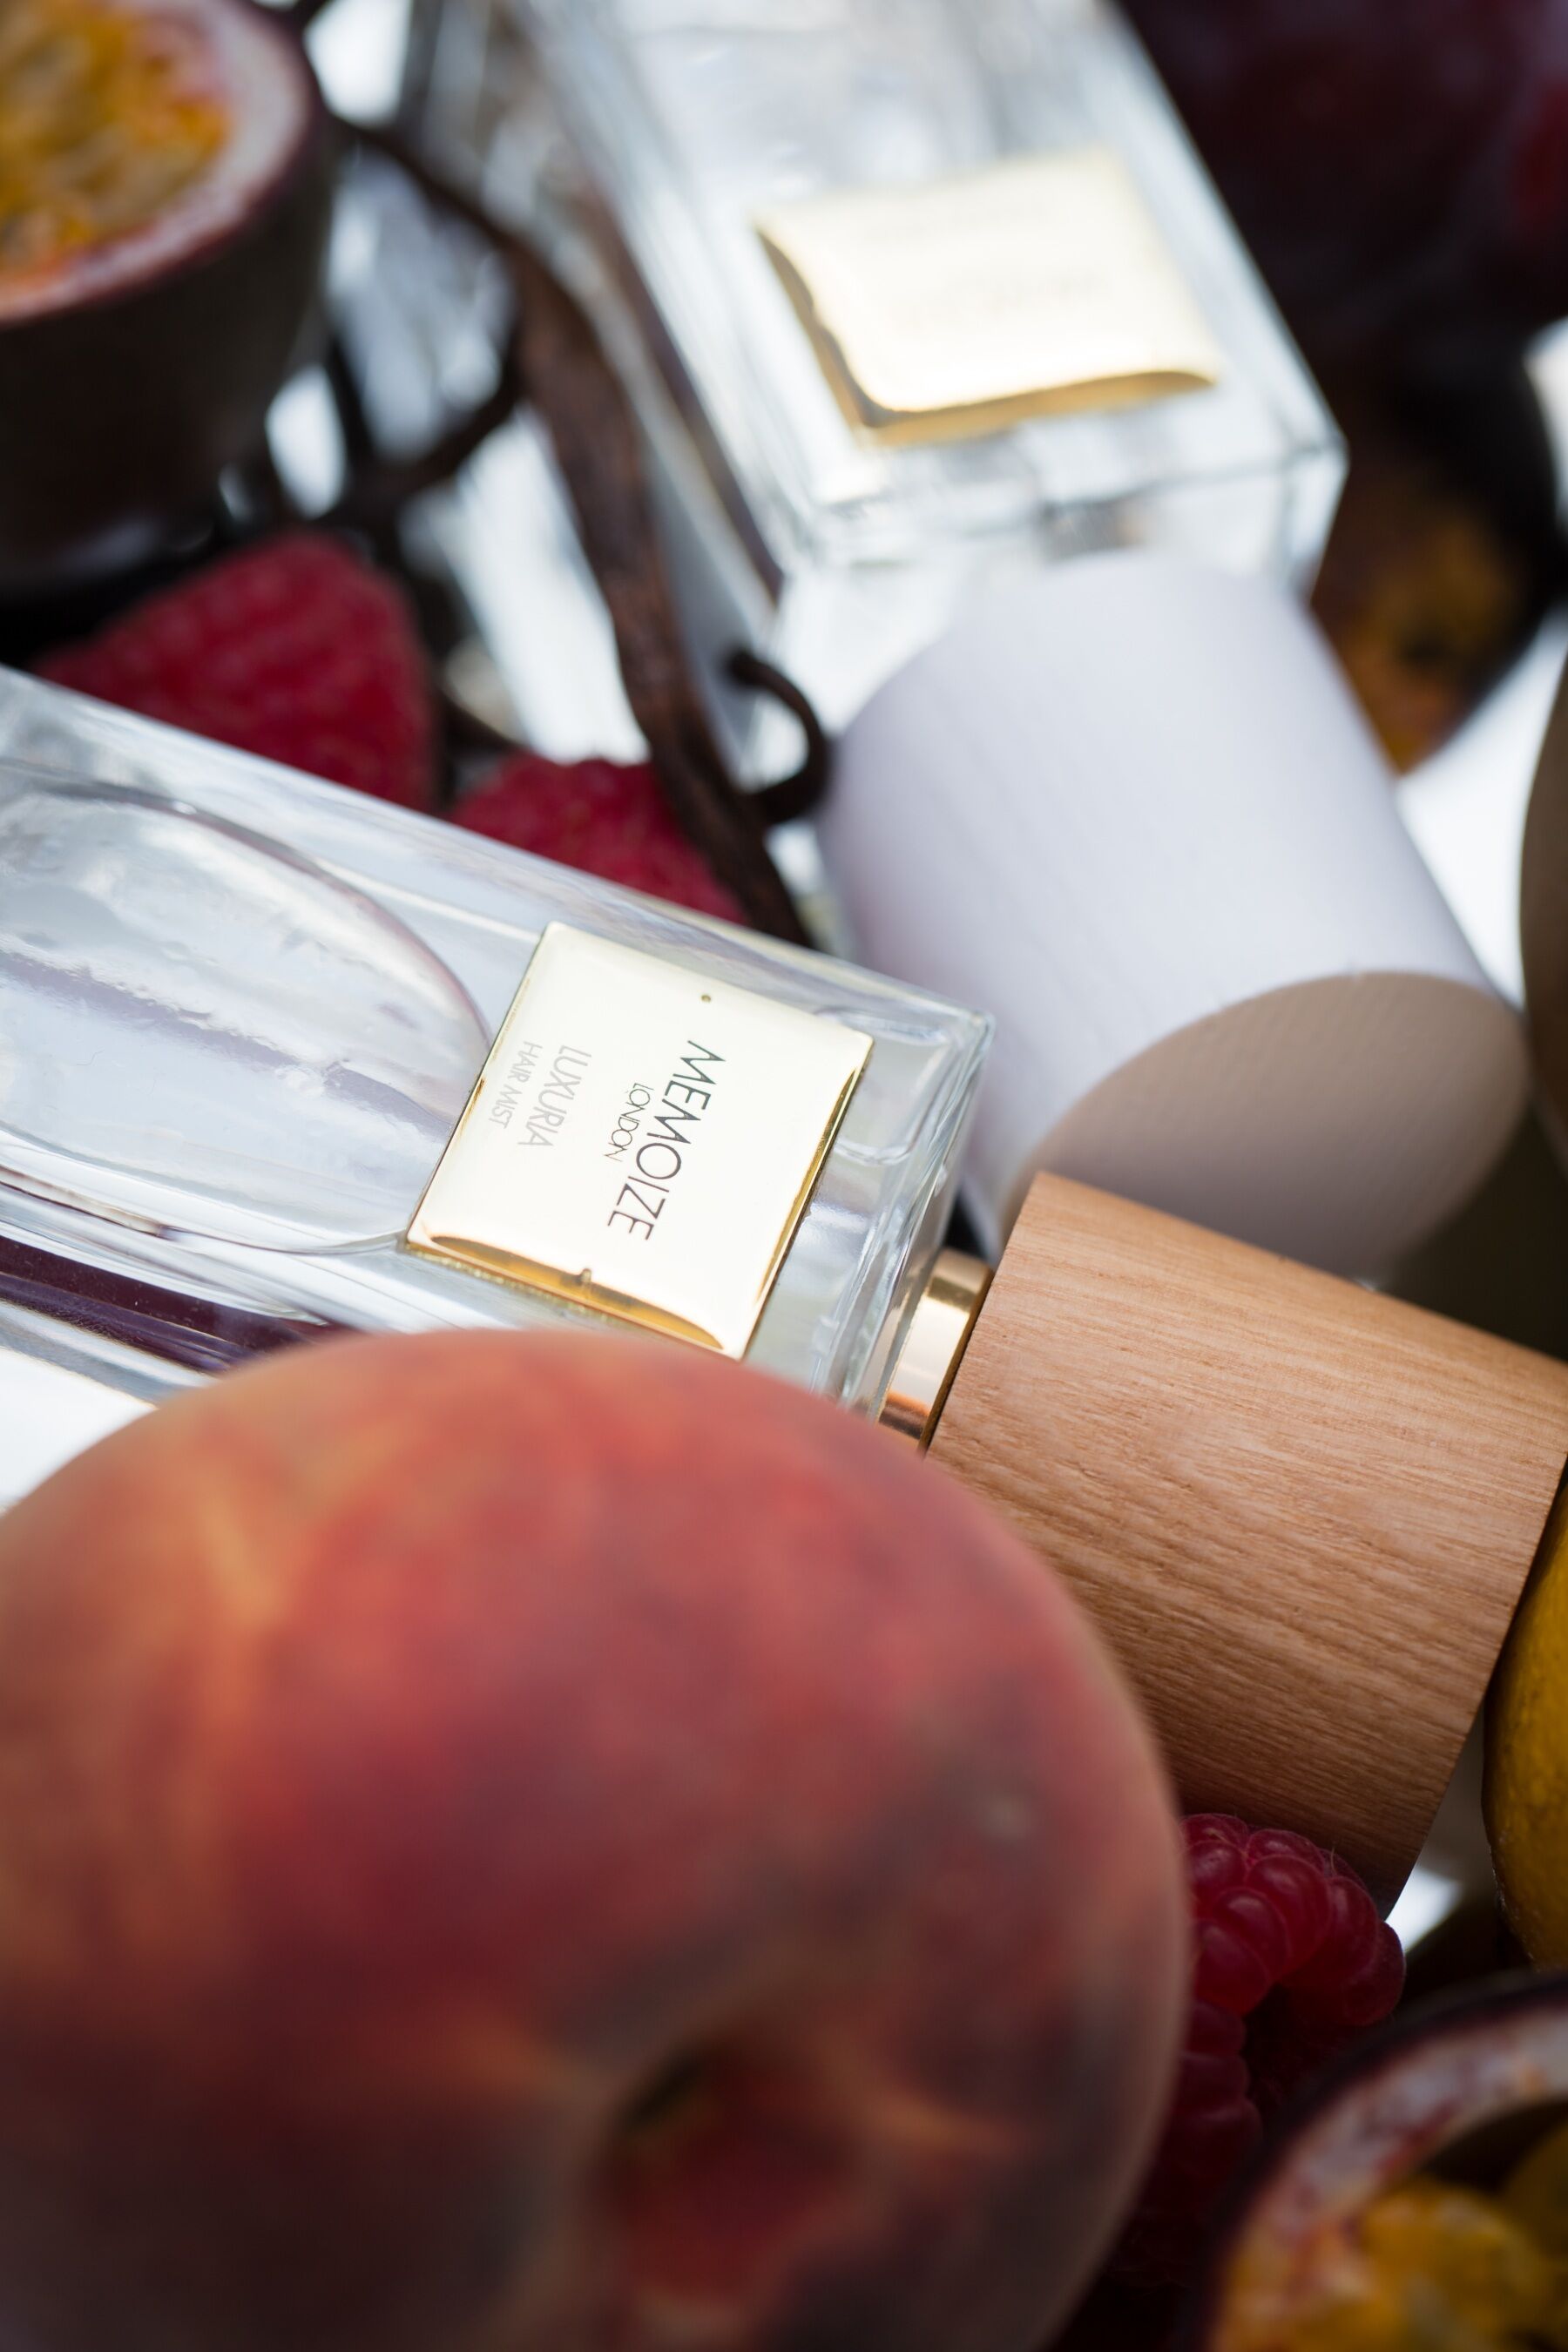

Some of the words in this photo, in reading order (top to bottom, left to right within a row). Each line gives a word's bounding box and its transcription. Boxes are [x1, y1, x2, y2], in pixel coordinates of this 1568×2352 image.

[507, 1040, 543, 1083] HAIR
[517, 1044, 592, 1146] LUXURIA
[489, 1084, 523, 1129] MIST
[604, 1083, 654, 1162] LONDON
[607, 1040, 726, 1240] MEMOIZE
